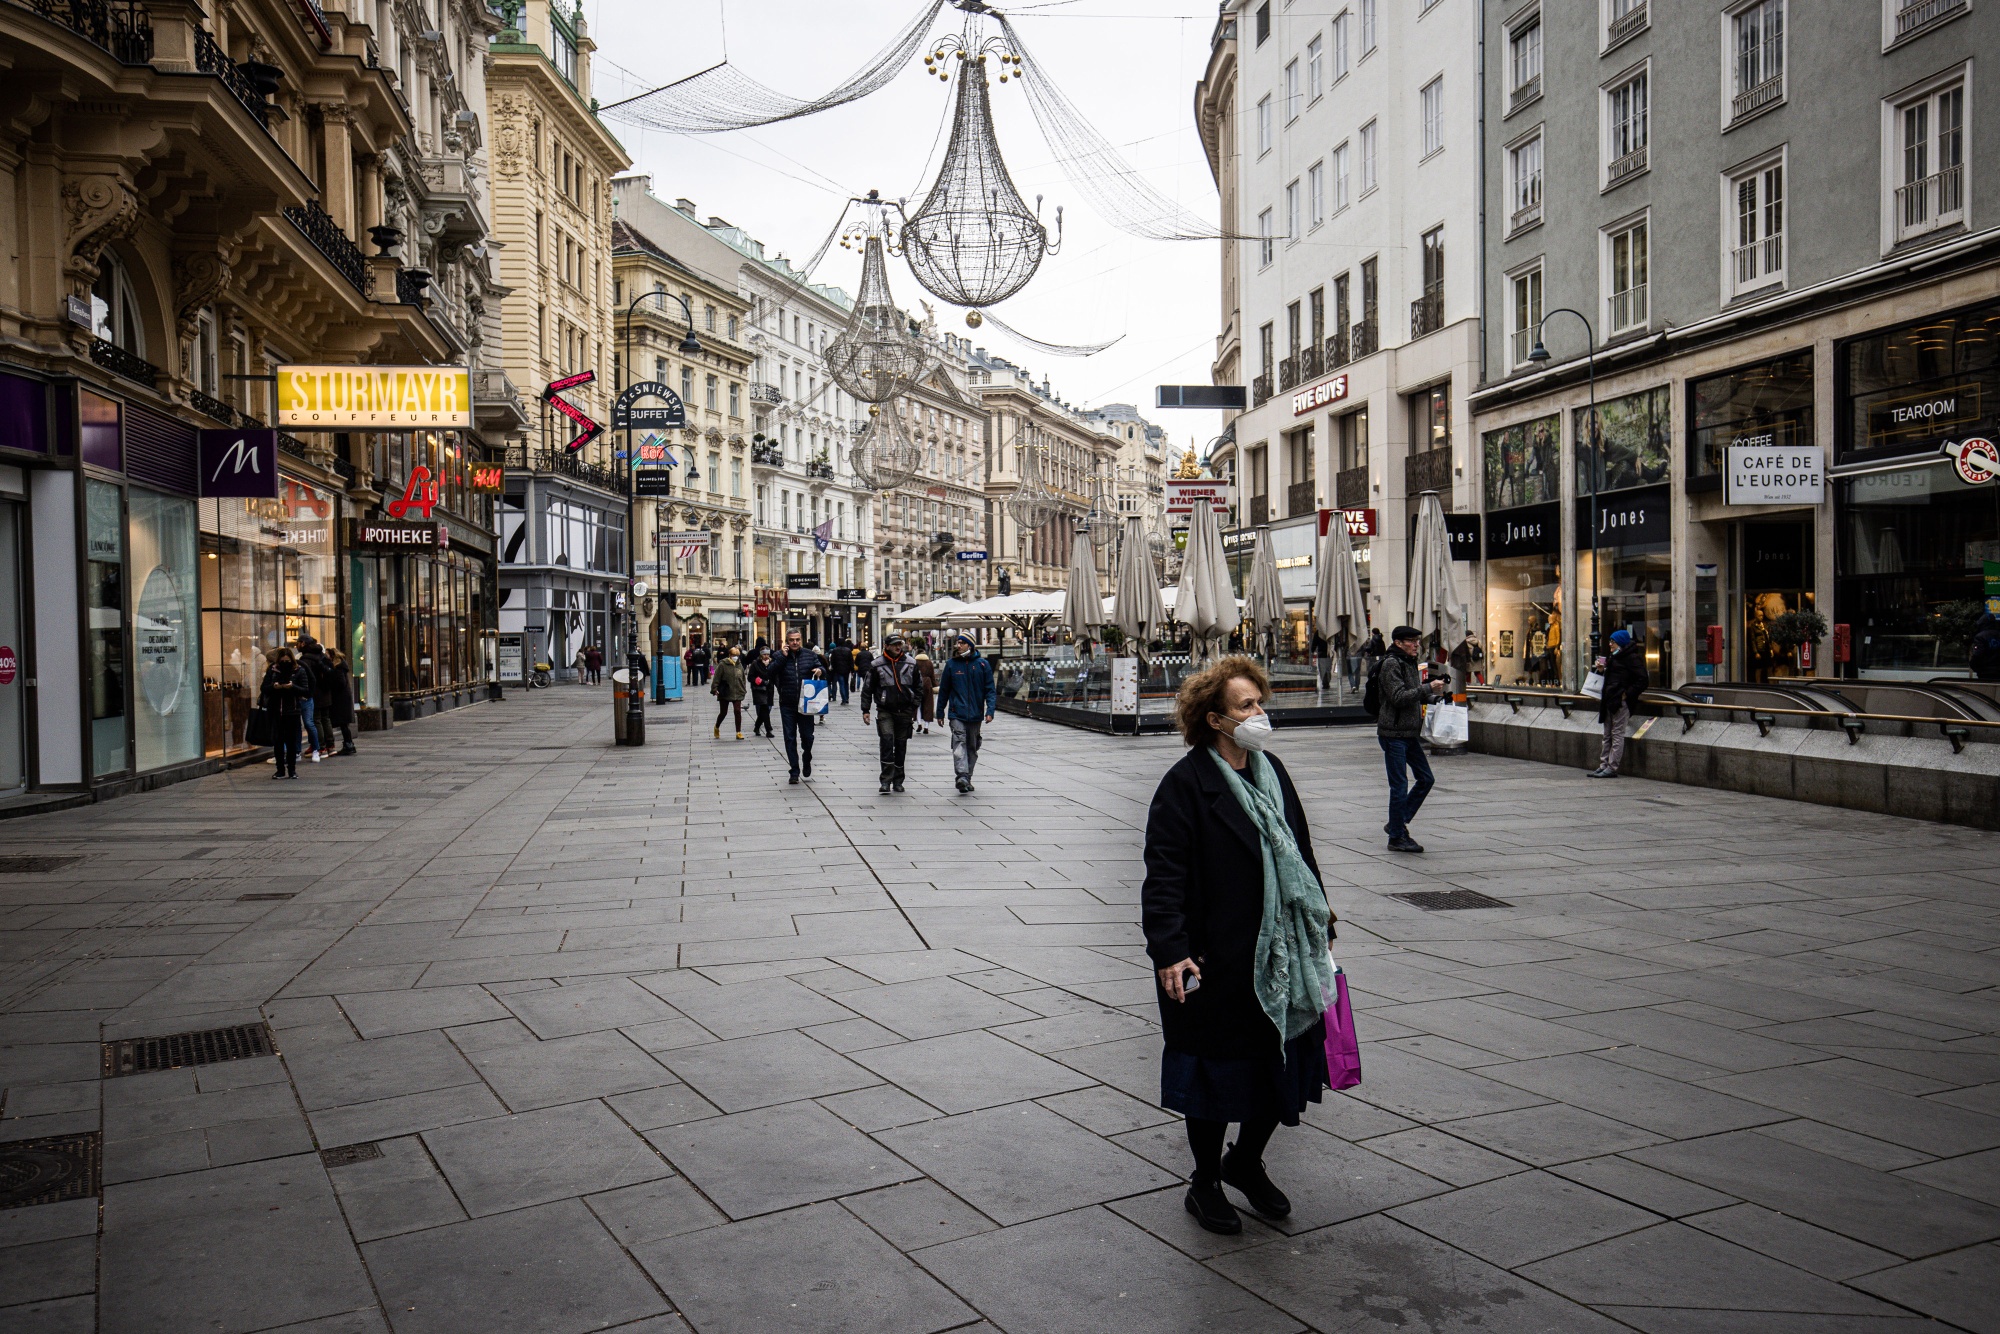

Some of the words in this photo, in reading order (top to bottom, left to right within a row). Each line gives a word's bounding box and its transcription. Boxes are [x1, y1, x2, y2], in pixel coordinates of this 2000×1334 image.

[290, 371, 457, 412] STURMAYR
[1293, 389, 1315, 414] FIVE
[1315, 377, 1345, 404] GUYS
[291, 413, 458, 422] COIFFEURE
[549, 395, 595, 432] FLEDERMAUS
[630, 410, 669, 419] BUFFET
[1891, 399, 1955, 422] TEAROOM
[1966, 441, 1996, 458] TABAK
[1743, 454, 1784, 468] CAFÉ
[1792, 456, 1812, 468] DE
[1961, 457, 1989, 480] TRAFIK
[473, 468, 502, 487] H&M
[1736, 474, 1819, 487] L'EUROPE
[1600, 508, 1645, 534] Jones
[365, 527, 432, 544] APOTHEKE
[1447, 531, 1474, 543] nes
[1505, 522, 1541, 545] Jones
[1756, 550, 1791, 562] Jones
[754, 588, 789, 612] LISKA
